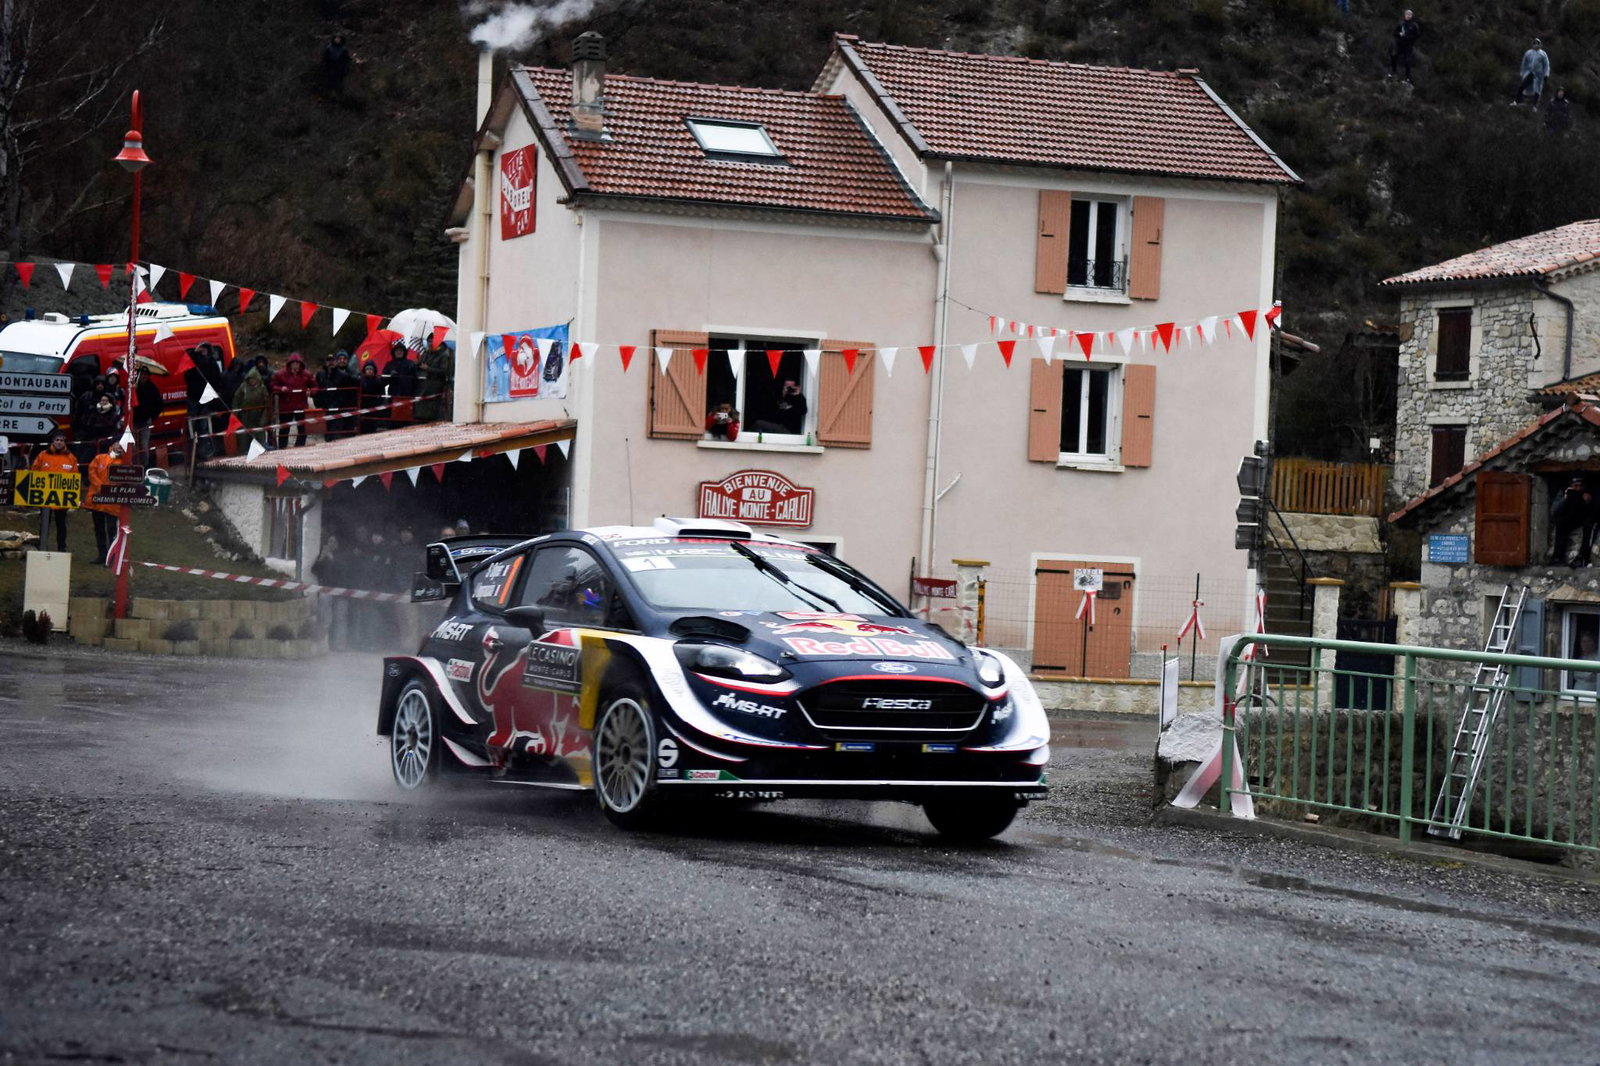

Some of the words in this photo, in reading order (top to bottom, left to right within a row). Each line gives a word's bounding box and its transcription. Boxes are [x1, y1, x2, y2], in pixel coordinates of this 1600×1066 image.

[19, 400, 32, 410] de
[38, 401, 67, 413] Perty
[37, 421, 45, 430] 8
[30, 472, 46, 489] Les
[49, 473, 80, 490] Tilleuls
[723, 475, 790, 497] BIENVENUE
[29, 490, 79, 507] BAR
[749, 489, 765, 500] AU
[704, 489, 737, 517] RALLYE
[613, 538, 671, 548] FORD
[783, 637, 883, 656] Red
[873, 638, 956, 660] Bull
[862, 697, 932, 710] Fiesta
